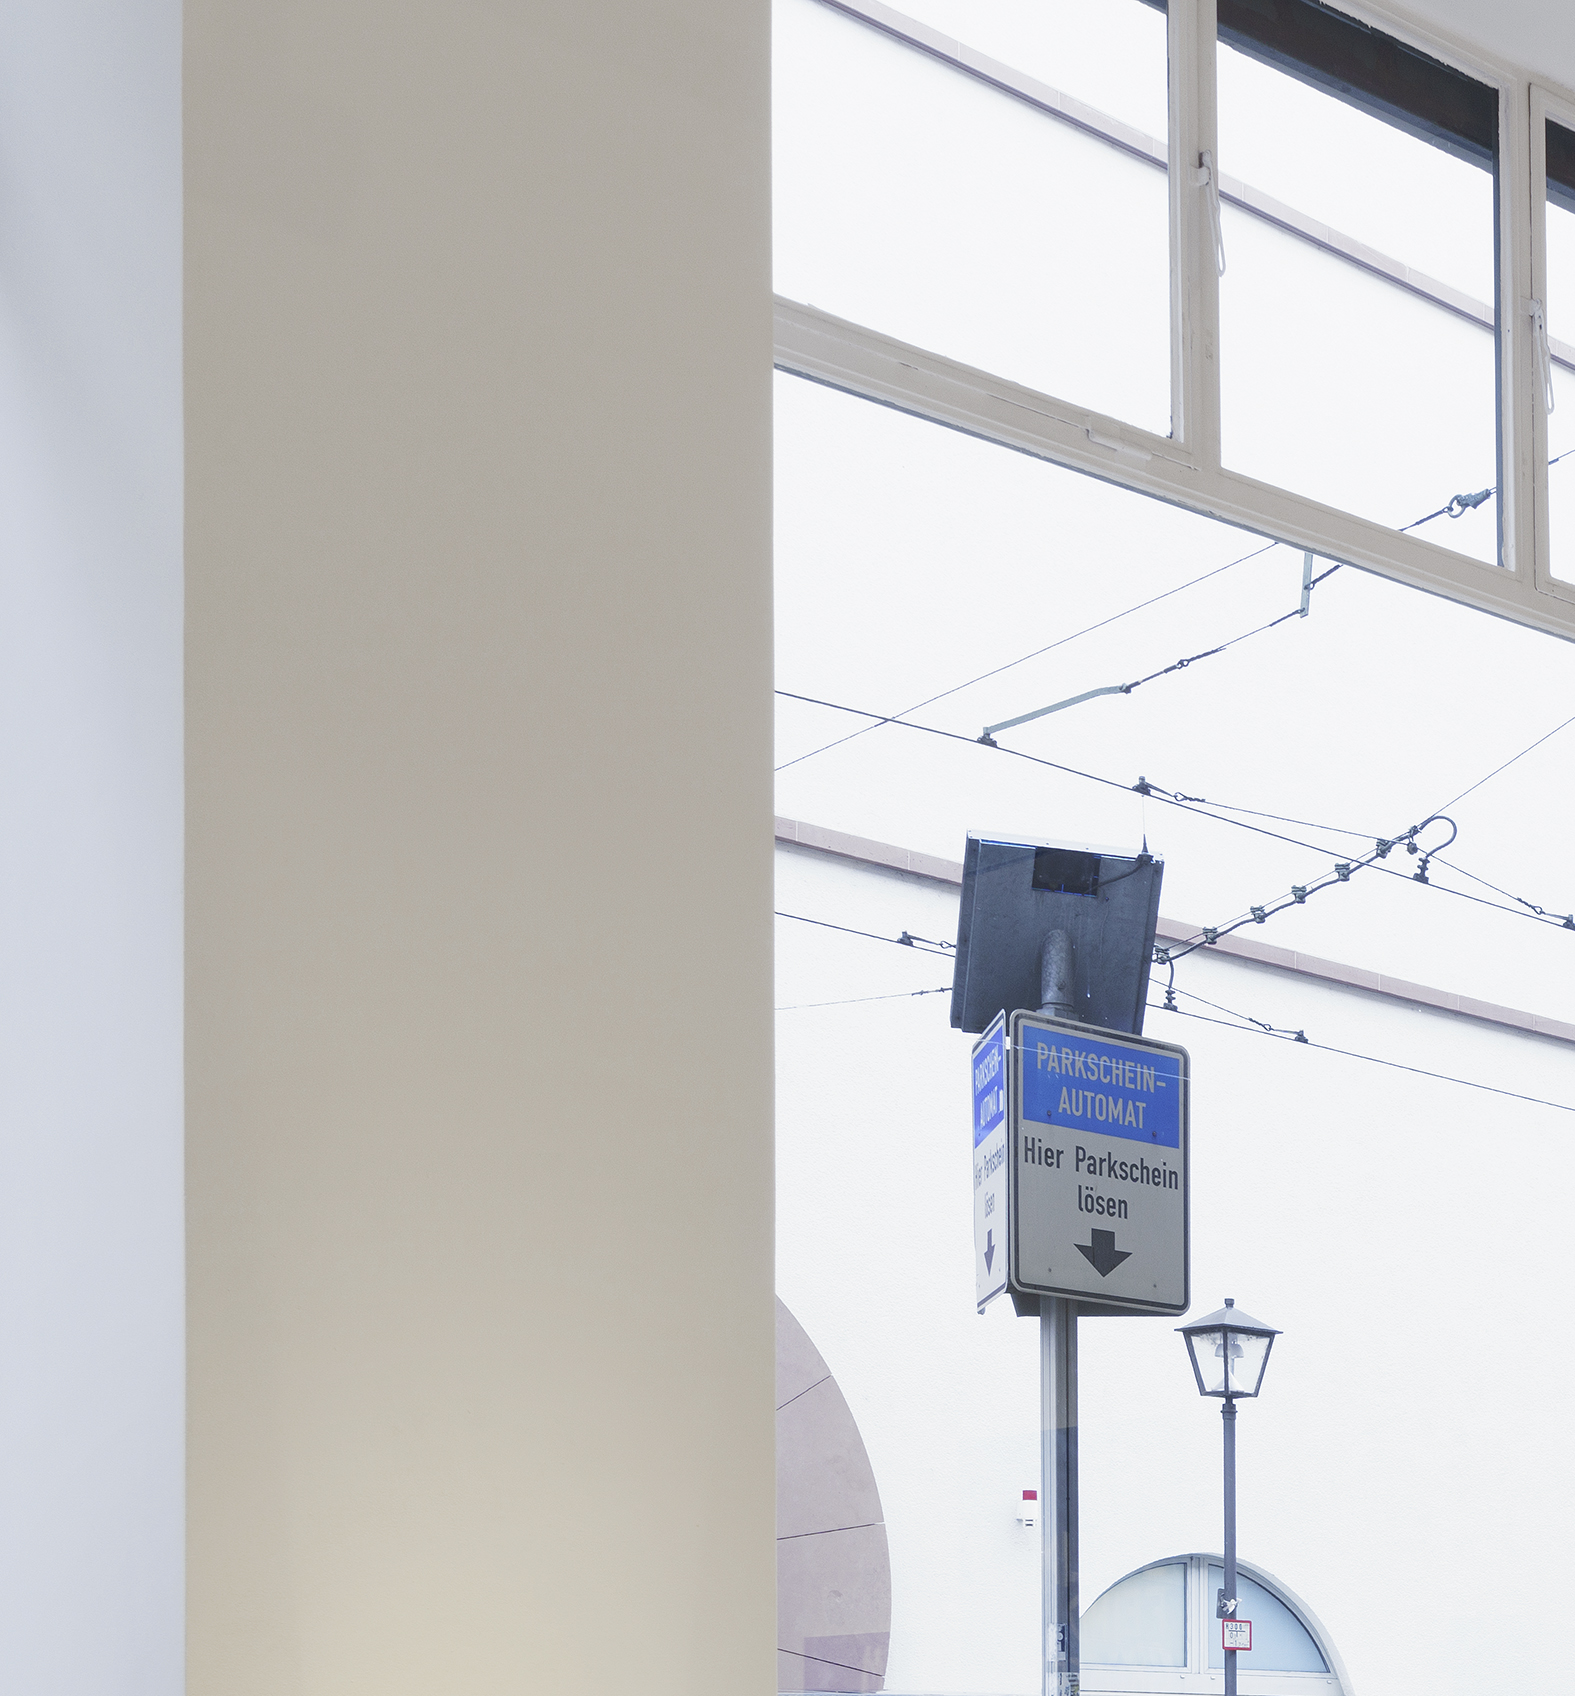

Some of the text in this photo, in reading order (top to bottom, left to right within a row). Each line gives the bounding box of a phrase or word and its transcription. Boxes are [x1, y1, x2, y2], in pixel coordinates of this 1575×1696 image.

[1037, 1042, 1166, 1093] PARKSCHEIN-
[979, 1085, 999, 1130] AUTOMAT
[1058, 1086, 1146, 1129] AUTOMAT
[983, 1138, 1005, 1181] Parkschein
[1024, 1136, 1179, 1190] Hier Parkschein
[1078, 1184, 1128, 1219] lösen
